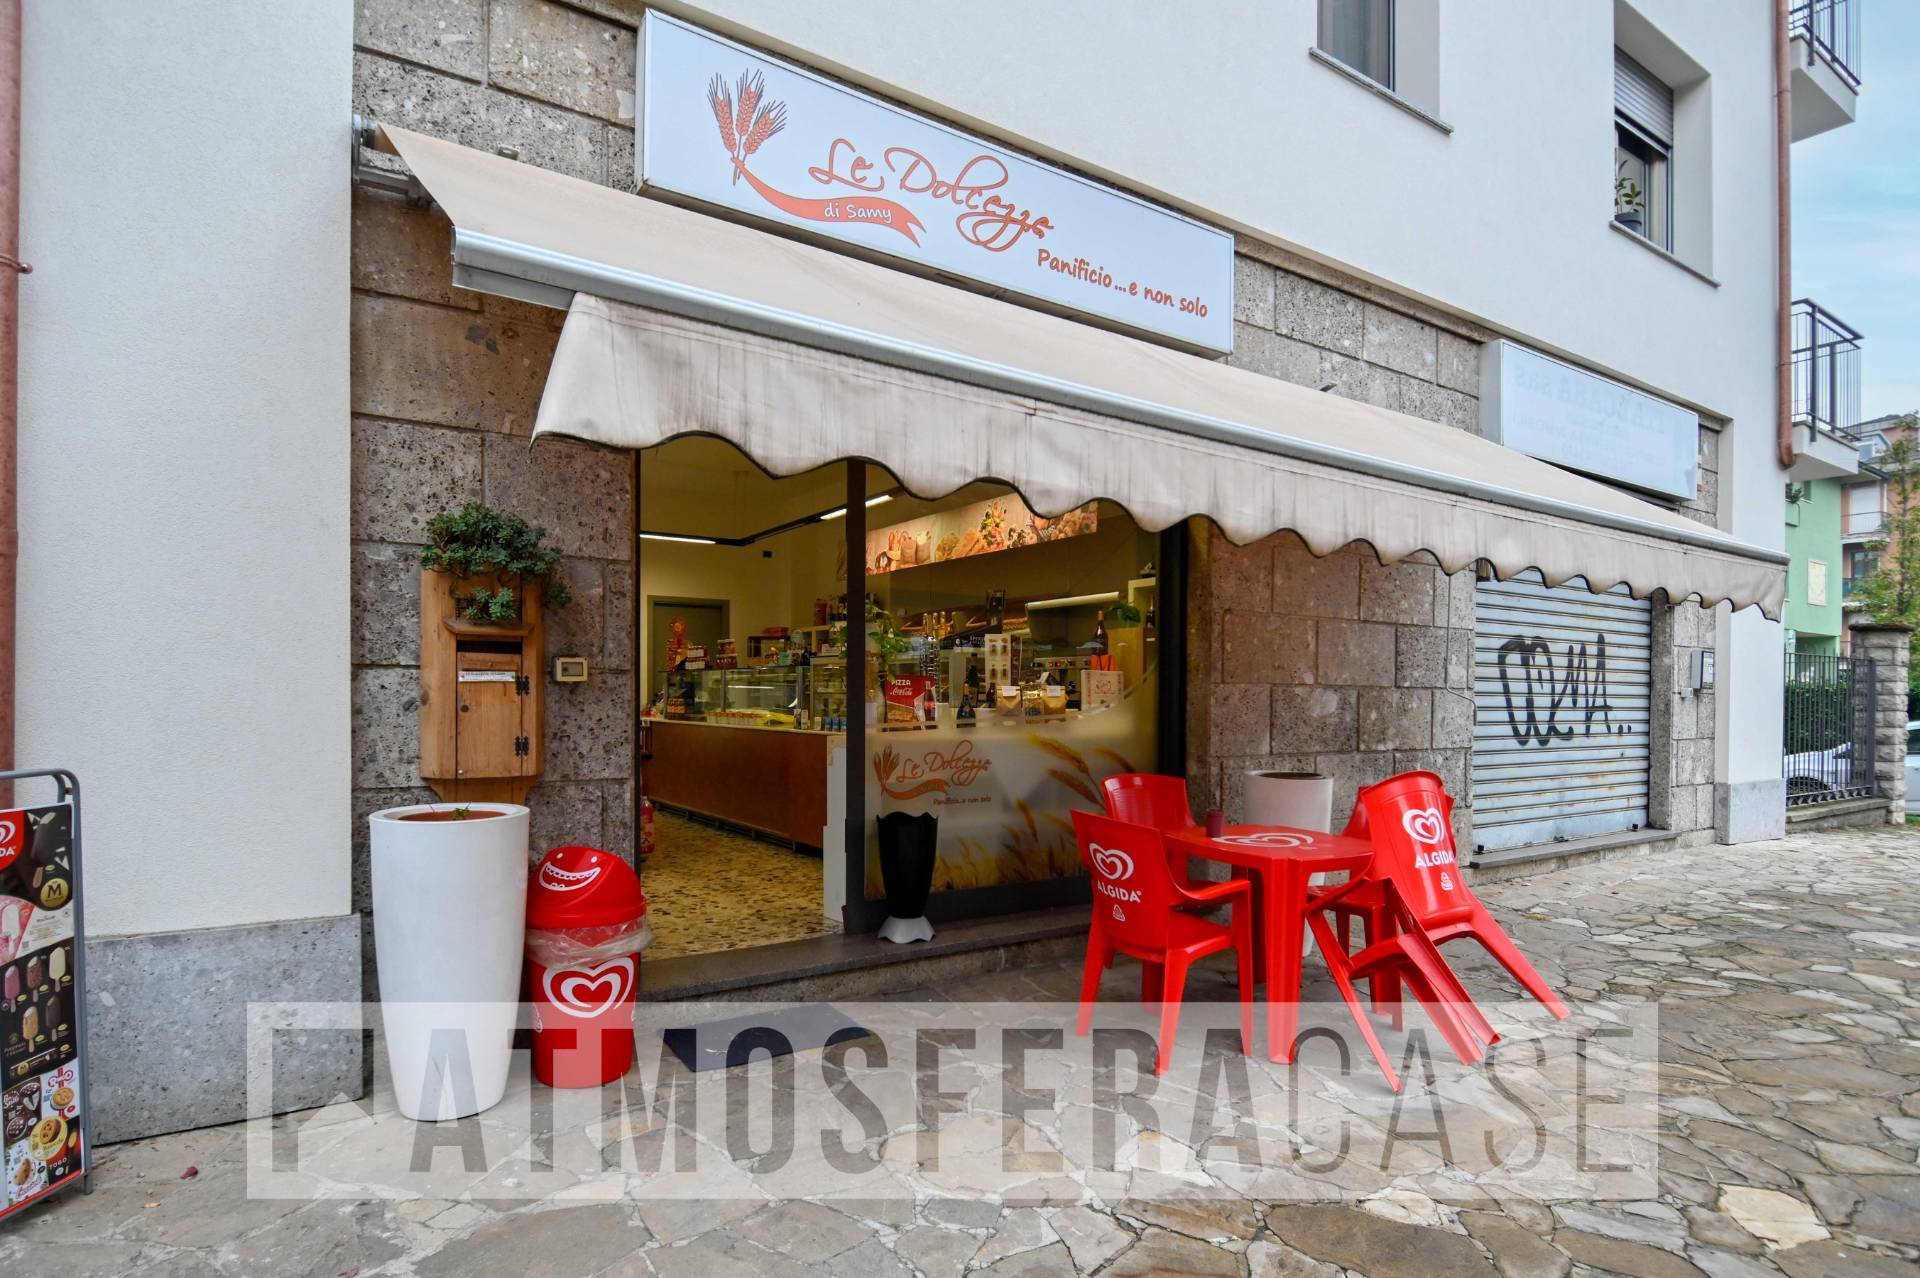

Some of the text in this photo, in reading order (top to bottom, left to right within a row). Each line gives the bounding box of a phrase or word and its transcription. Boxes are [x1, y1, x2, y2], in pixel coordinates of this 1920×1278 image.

[808, 138, 1055, 251] Le Dolcezze
[824, 202, 892, 223] di Samy
[1144, 286, 1174, 307] non
[1179, 297, 1208, 318] solo
[1416, 849, 1456, 868] ALGIDA
[1097, 880, 1142, 904] ALGIDA
